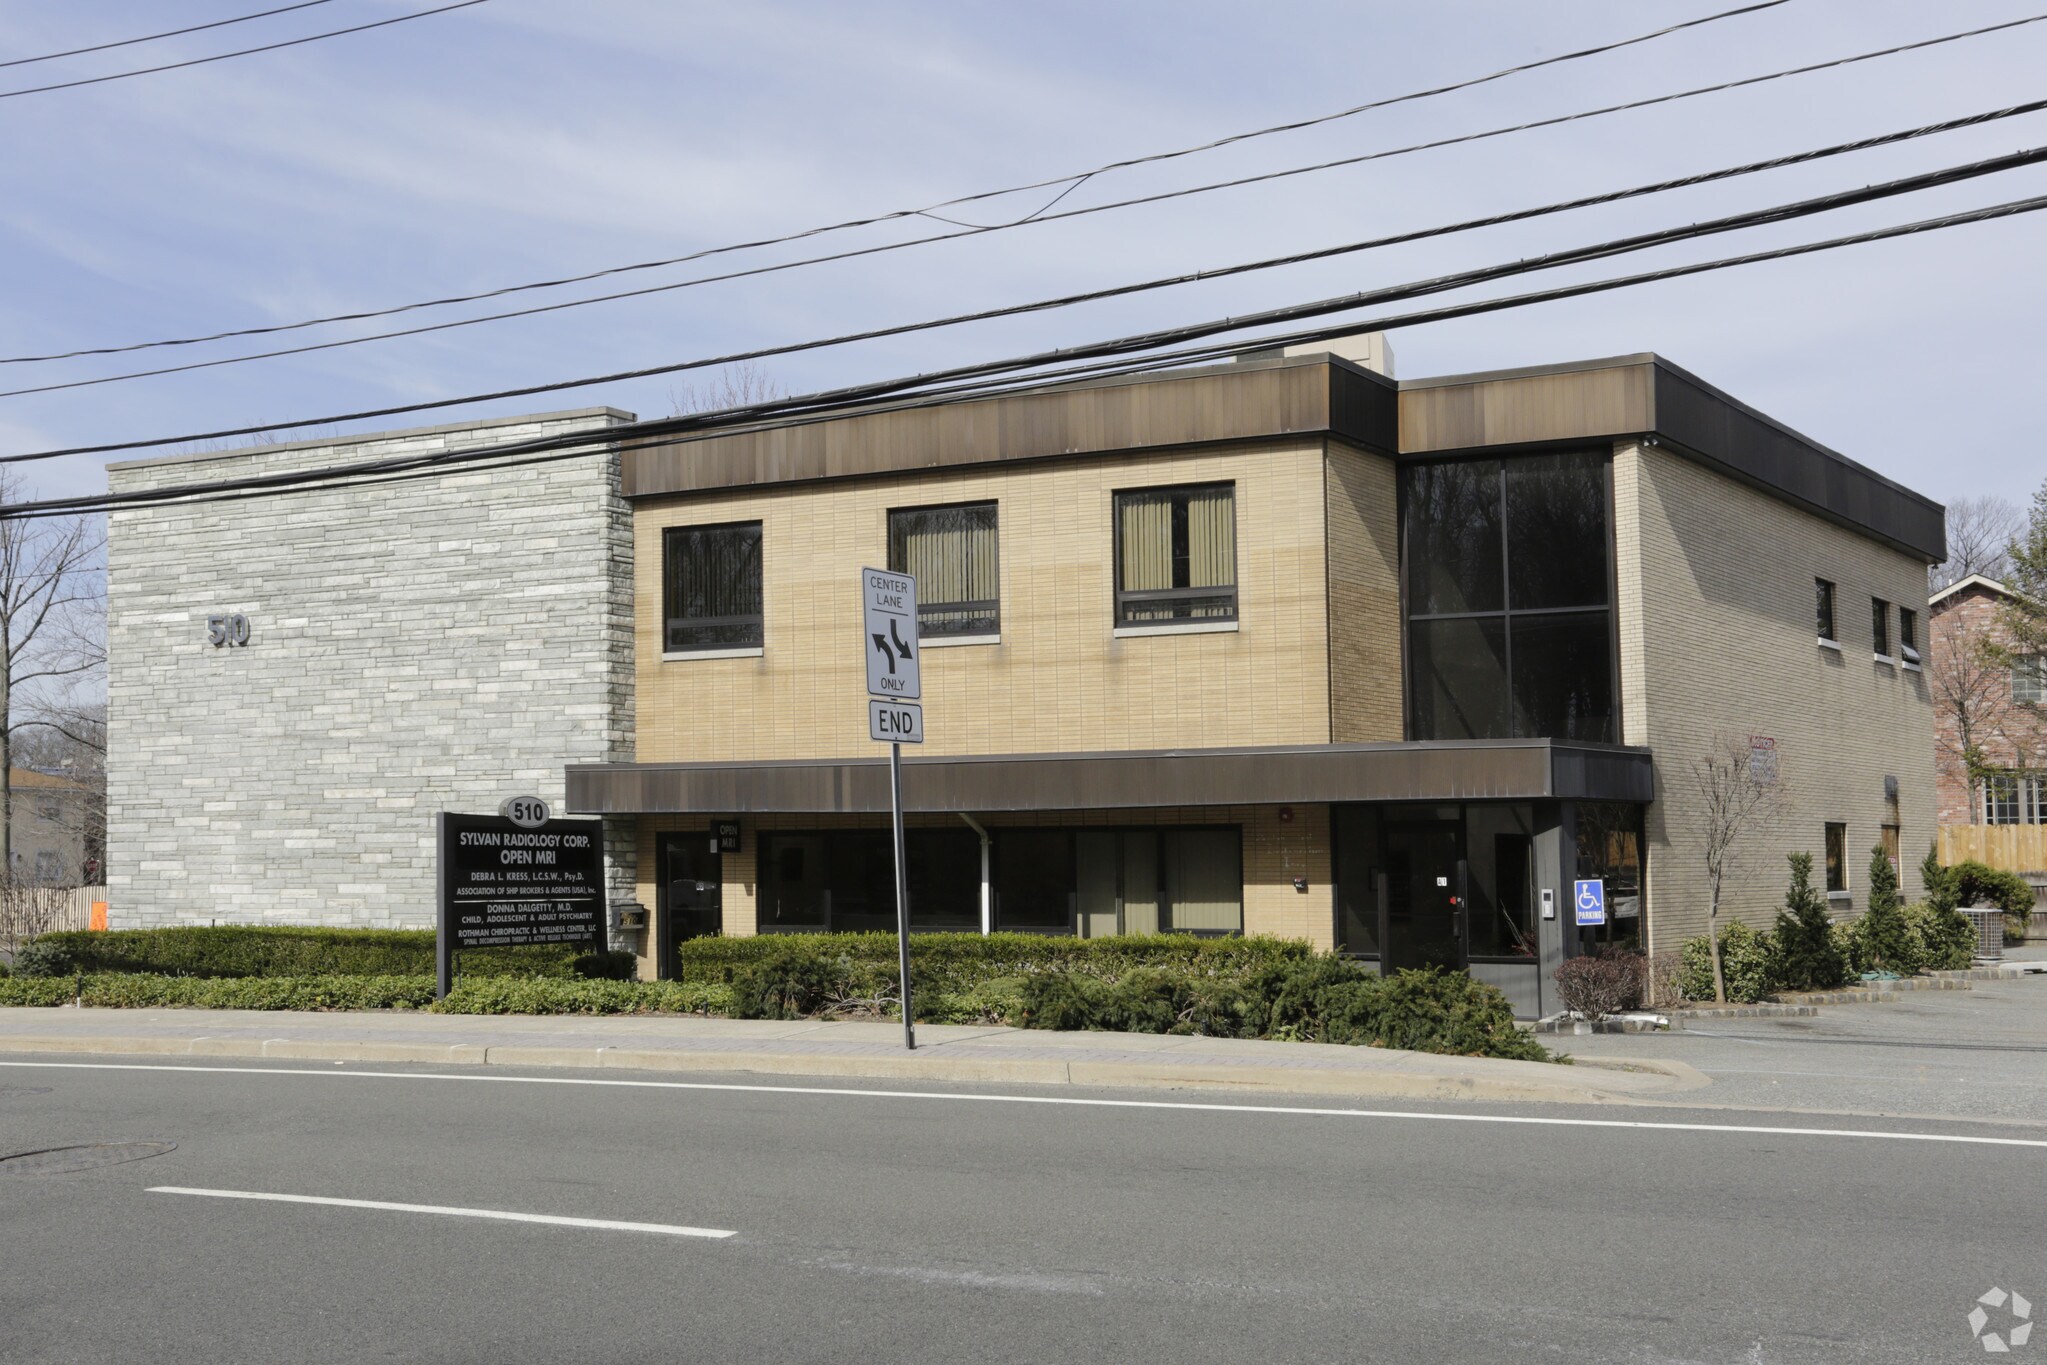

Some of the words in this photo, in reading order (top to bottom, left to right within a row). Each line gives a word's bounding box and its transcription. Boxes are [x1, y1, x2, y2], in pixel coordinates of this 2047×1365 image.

[870, 576, 908, 594] CENTER
[876, 593, 903, 609] LANE
[881, 677, 906, 691] ONLY
[879, 709, 913, 734] END
[514, 803, 544, 821] 510
[720, 824, 738, 835] OPEN
[460, 832, 500, 846] SYLVAN
[503, 833, 561, 847] RADIOLOGY
[563, 835, 590, 848] CORP.
[721, 837, 736, 848] MRI
[500, 849, 532, 864] OPEN
[535, 850, 556, 864] MRI
[471, 872, 496, 881] DEBRA
[506, 872, 531, 882] KRESS,
[564, 872, 585, 882] Psy.D.
[456, 887, 496, 895] ASSOCIATION
[497, 887, 505, 895] OF
[506, 887, 519, 895] SHIP
[519, 886, 544, 895] BROKERS
[551, 886, 571, 894] AGENTS
[487, 904, 516, 913] DONNA
[518, 903, 555, 913] DALGETTY,
[557, 903, 573, 911] M.D.
[461, 916, 484, 924] CHILD,
[487, 914, 527, 923] ADOLESCENT
[538, 913, 557, 921] ADULT
[559, 912, 593, 920] PSYCHIATRY
[1578, 910, 1602, 920] PARKING
[458, 928, 489, 938] ROTHMAN
[491, 927, 530, 937] CHIROPRACTIC
[532, 926, 537, 934] &
[540, 925, 565, 934] WELLNESS
